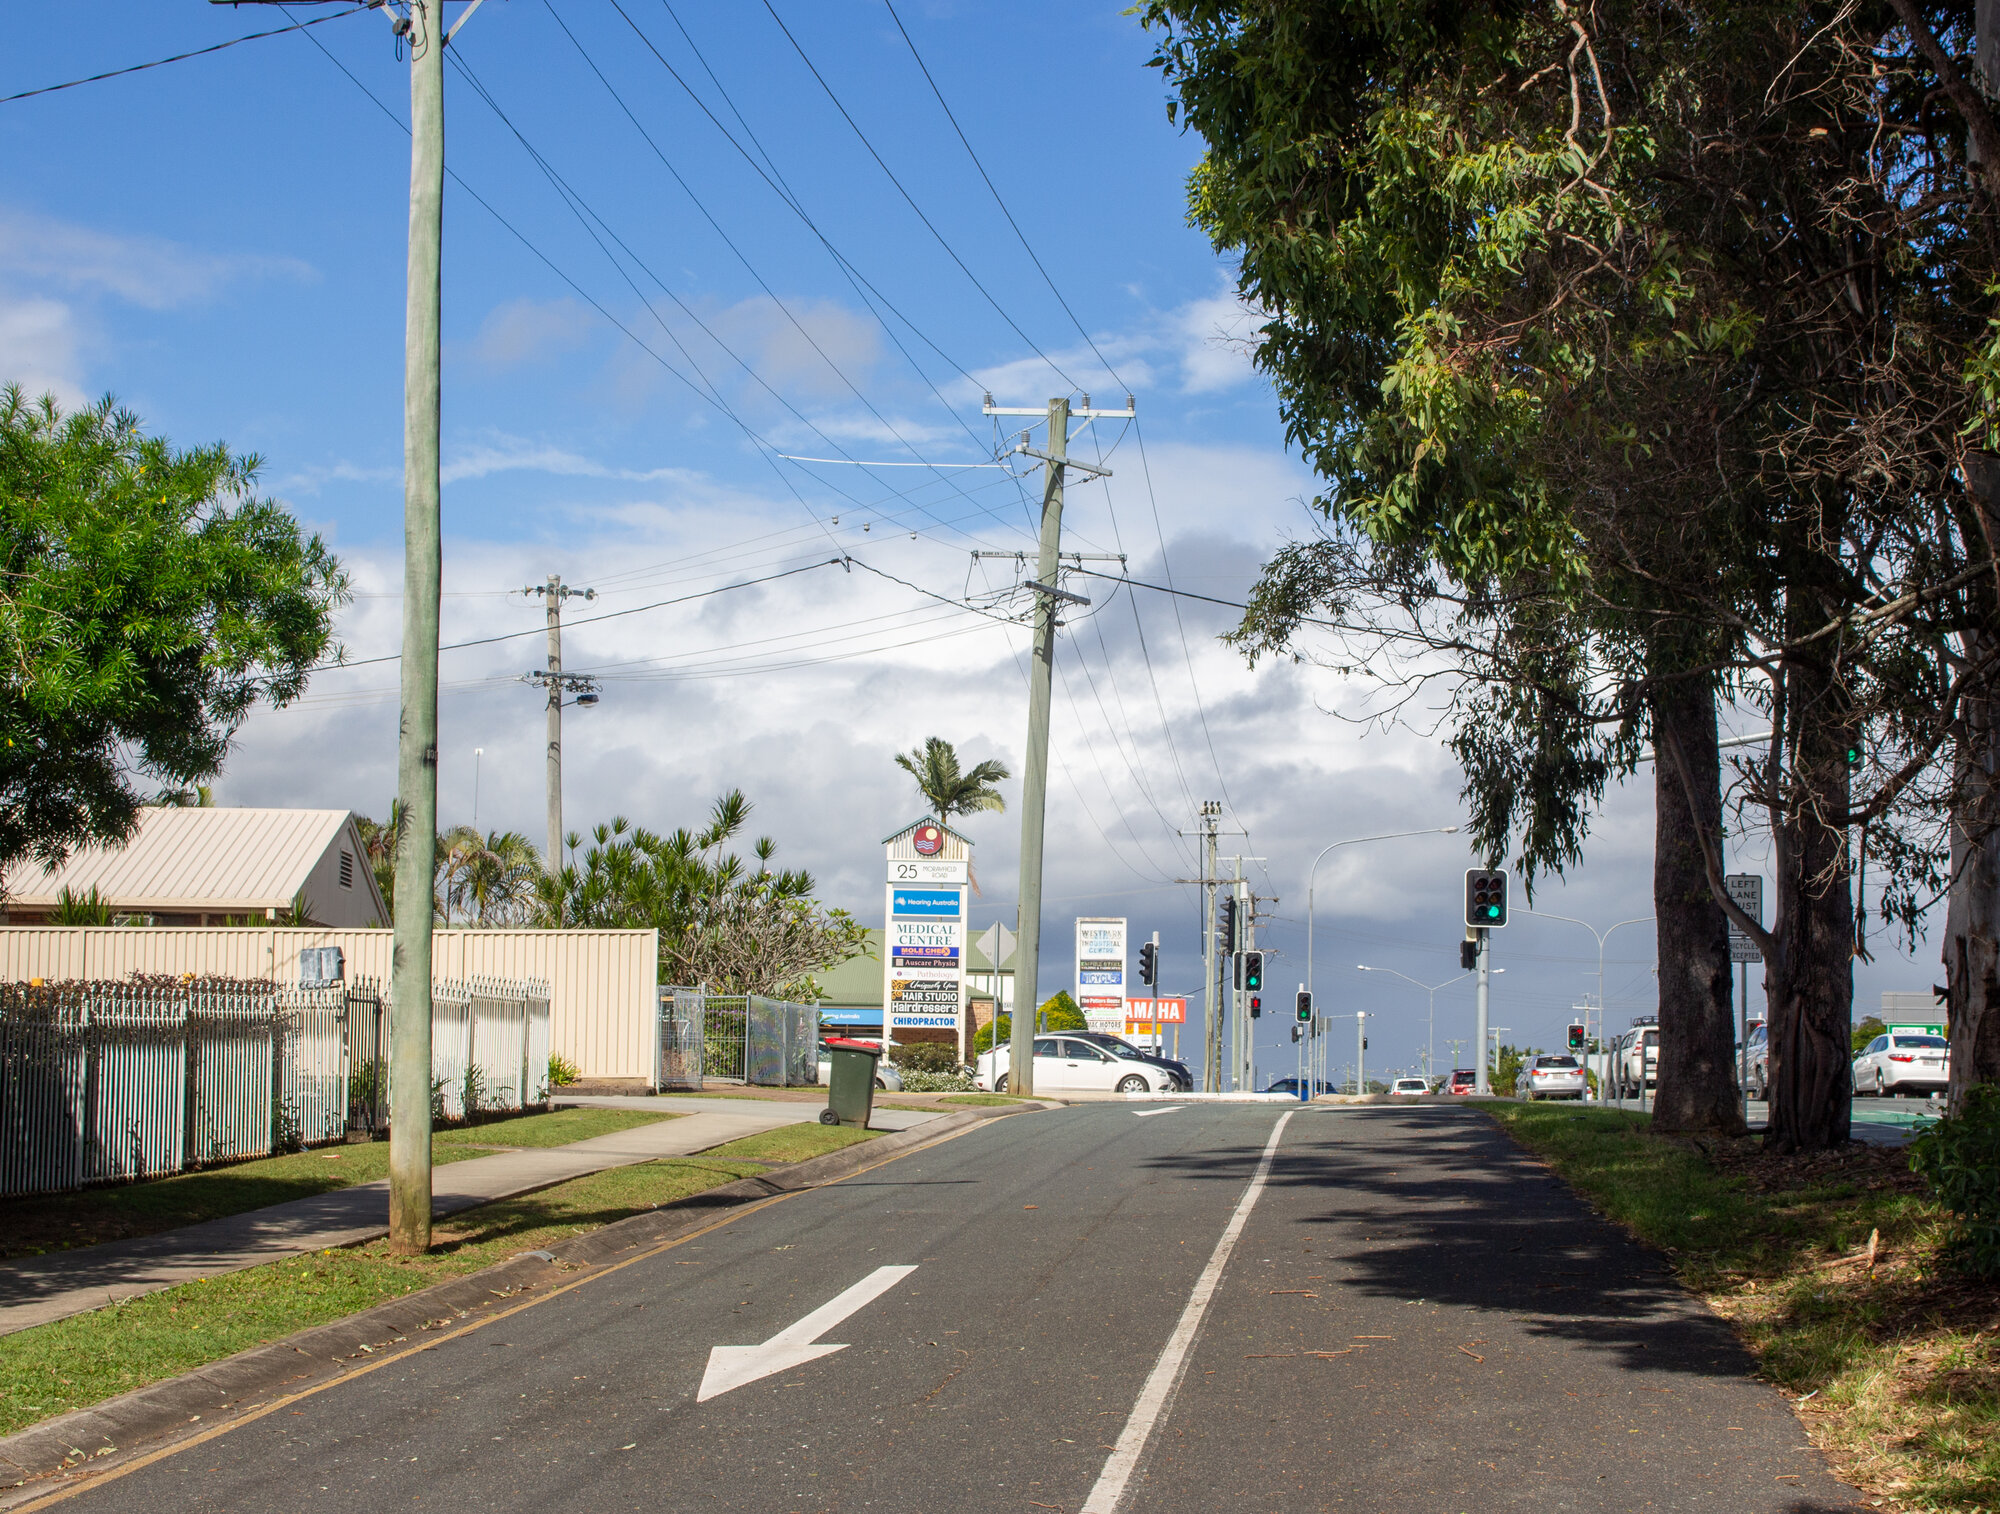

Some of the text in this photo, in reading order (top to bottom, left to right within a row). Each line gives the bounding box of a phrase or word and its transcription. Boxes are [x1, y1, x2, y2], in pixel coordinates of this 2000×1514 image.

[897, 864, 918, 879] 25
[1731, 880, 1756, 888] LEFT
[1731, 891, 1757, 899] LANE
[907, 898, 931, 907] Hearing
[1738, 902, 1758, 910] UST
[897, 924, 956, 935] MEDICAL
[899, 935, 952, 945] CENTRE
[1732, 952, 1760, 960] XCEPTED
[917, 969, 954, 979] Pathology
[910, 980, 957, 990] Uniquely You
[902, 992, 957, 1002] HAIR STUDIO
[891, 1002, 958, 1013] Hairdressers
[893, 1017, 955, 1026] CHIROPRACTOR
